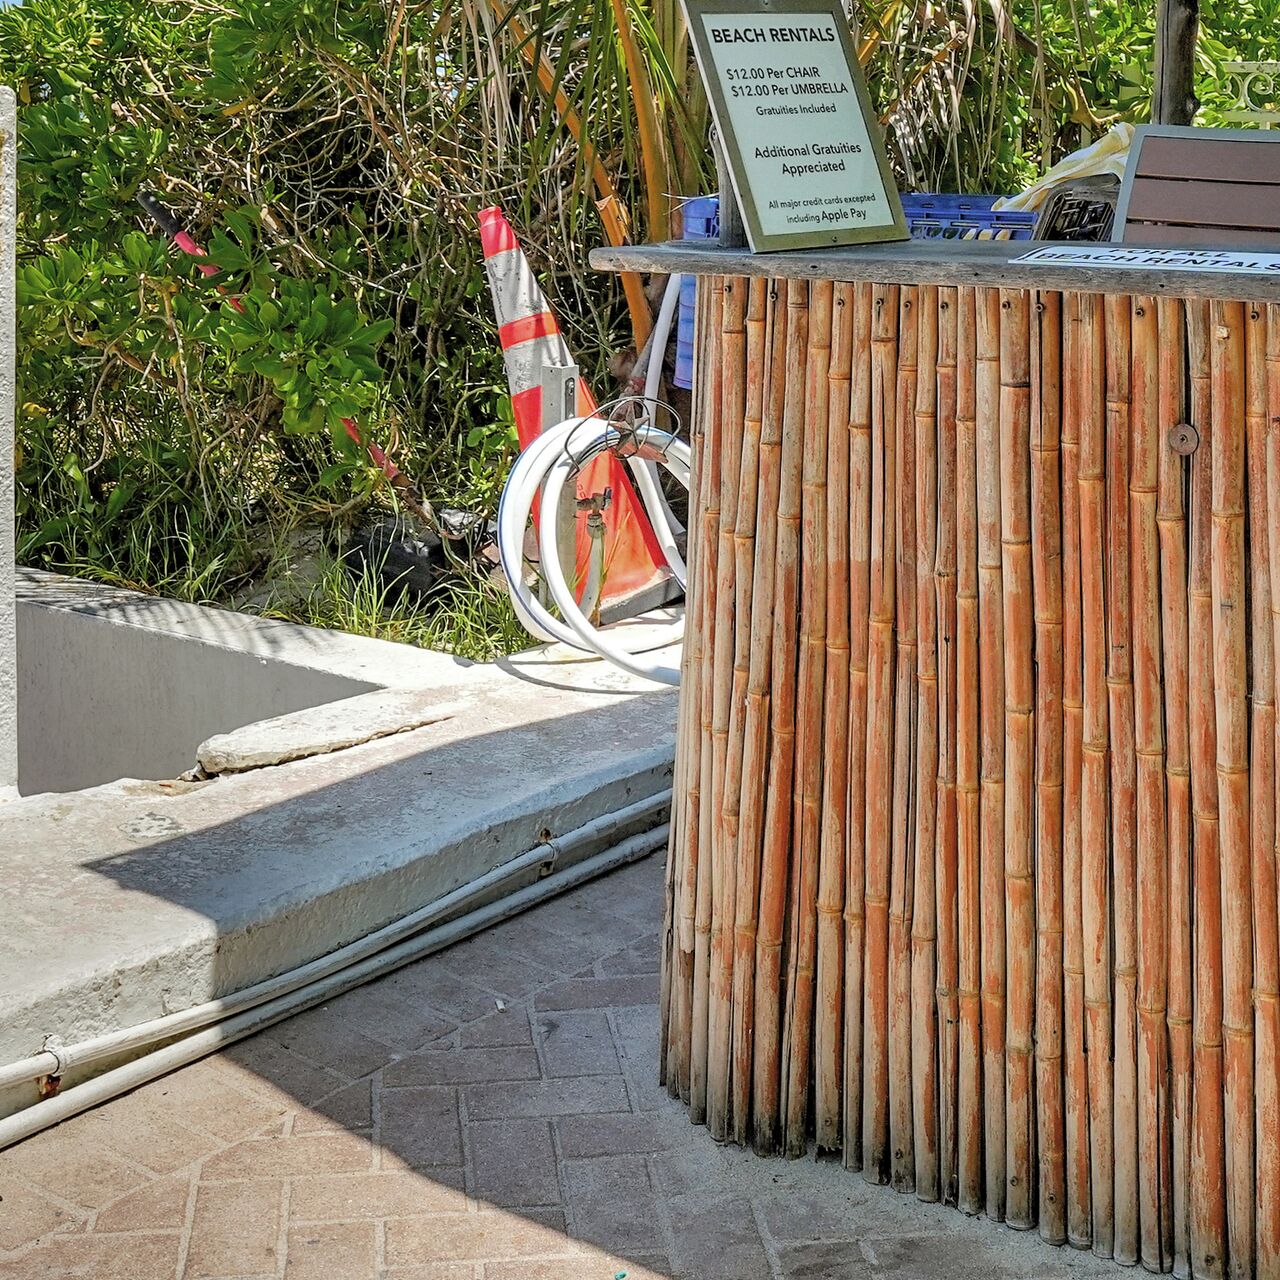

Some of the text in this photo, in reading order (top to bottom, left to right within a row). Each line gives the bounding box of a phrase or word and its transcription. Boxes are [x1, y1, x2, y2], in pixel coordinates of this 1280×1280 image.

[712, 27, 835, 43] BEACH RENTALS
[727, 67, 820, 80] $12.00 Per CHAIR
[731, 83, 848, 97] $12.00 Per UMBRELLA
[756, 103, 836, 115] Gratuities Included
[755, 143, 862, 158] Additional Gratuities
[782, 159, 845, 177] Appreciated
[769, 193, 876, 209] All major credit cards excepted
[787, 208, 866, 223] including Apple Pay
[1034, 253, 1138, 262] BEACH
